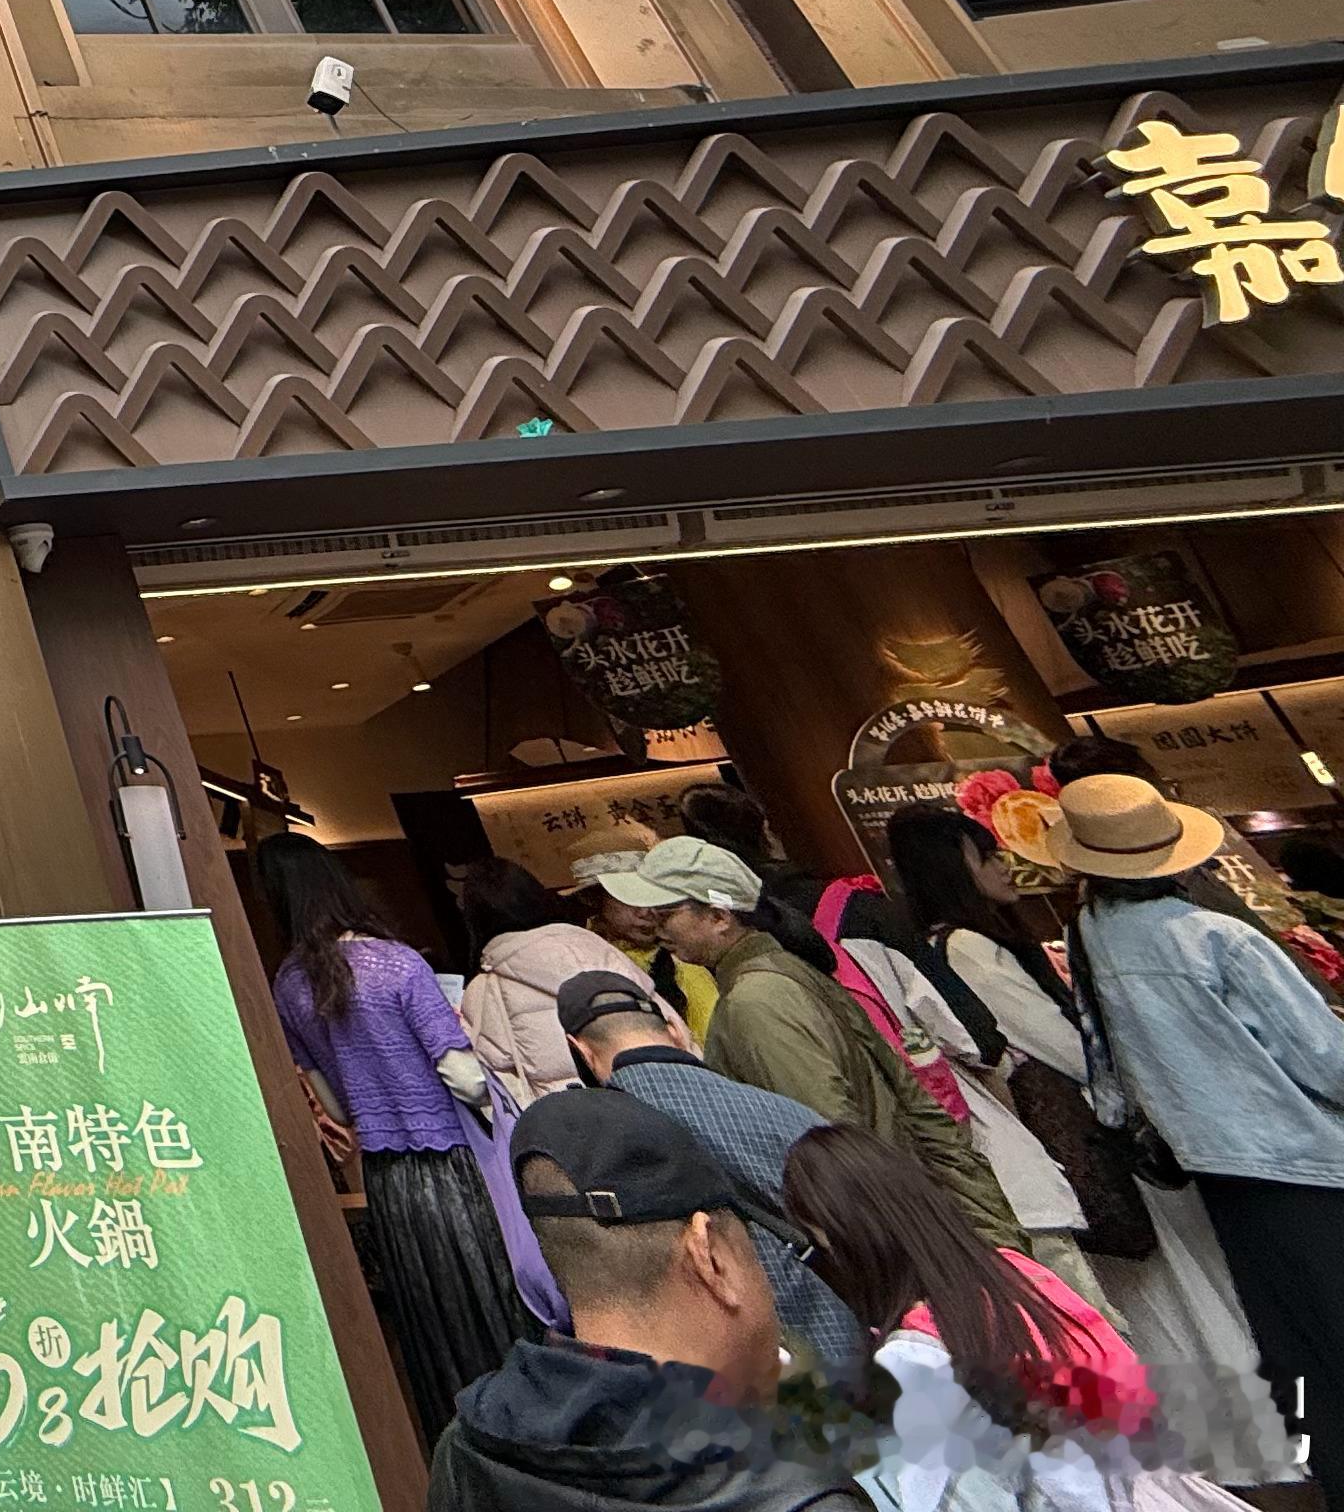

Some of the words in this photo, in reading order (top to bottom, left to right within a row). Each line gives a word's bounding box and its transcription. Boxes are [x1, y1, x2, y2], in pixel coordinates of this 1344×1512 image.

[1106, 104, 1344, 322] 嘉
[1072, 600, 1202, 645] 头水花开
[576, 624, 690, 672] 头水花开
[1103, 632, 1211, 670] 趁鲜吃
[605, 656, 700, 697] 趁鲜吃
[26, 1198, 159, 1271] 火鍋
[75, 1294, 303, 1453] 抢购
